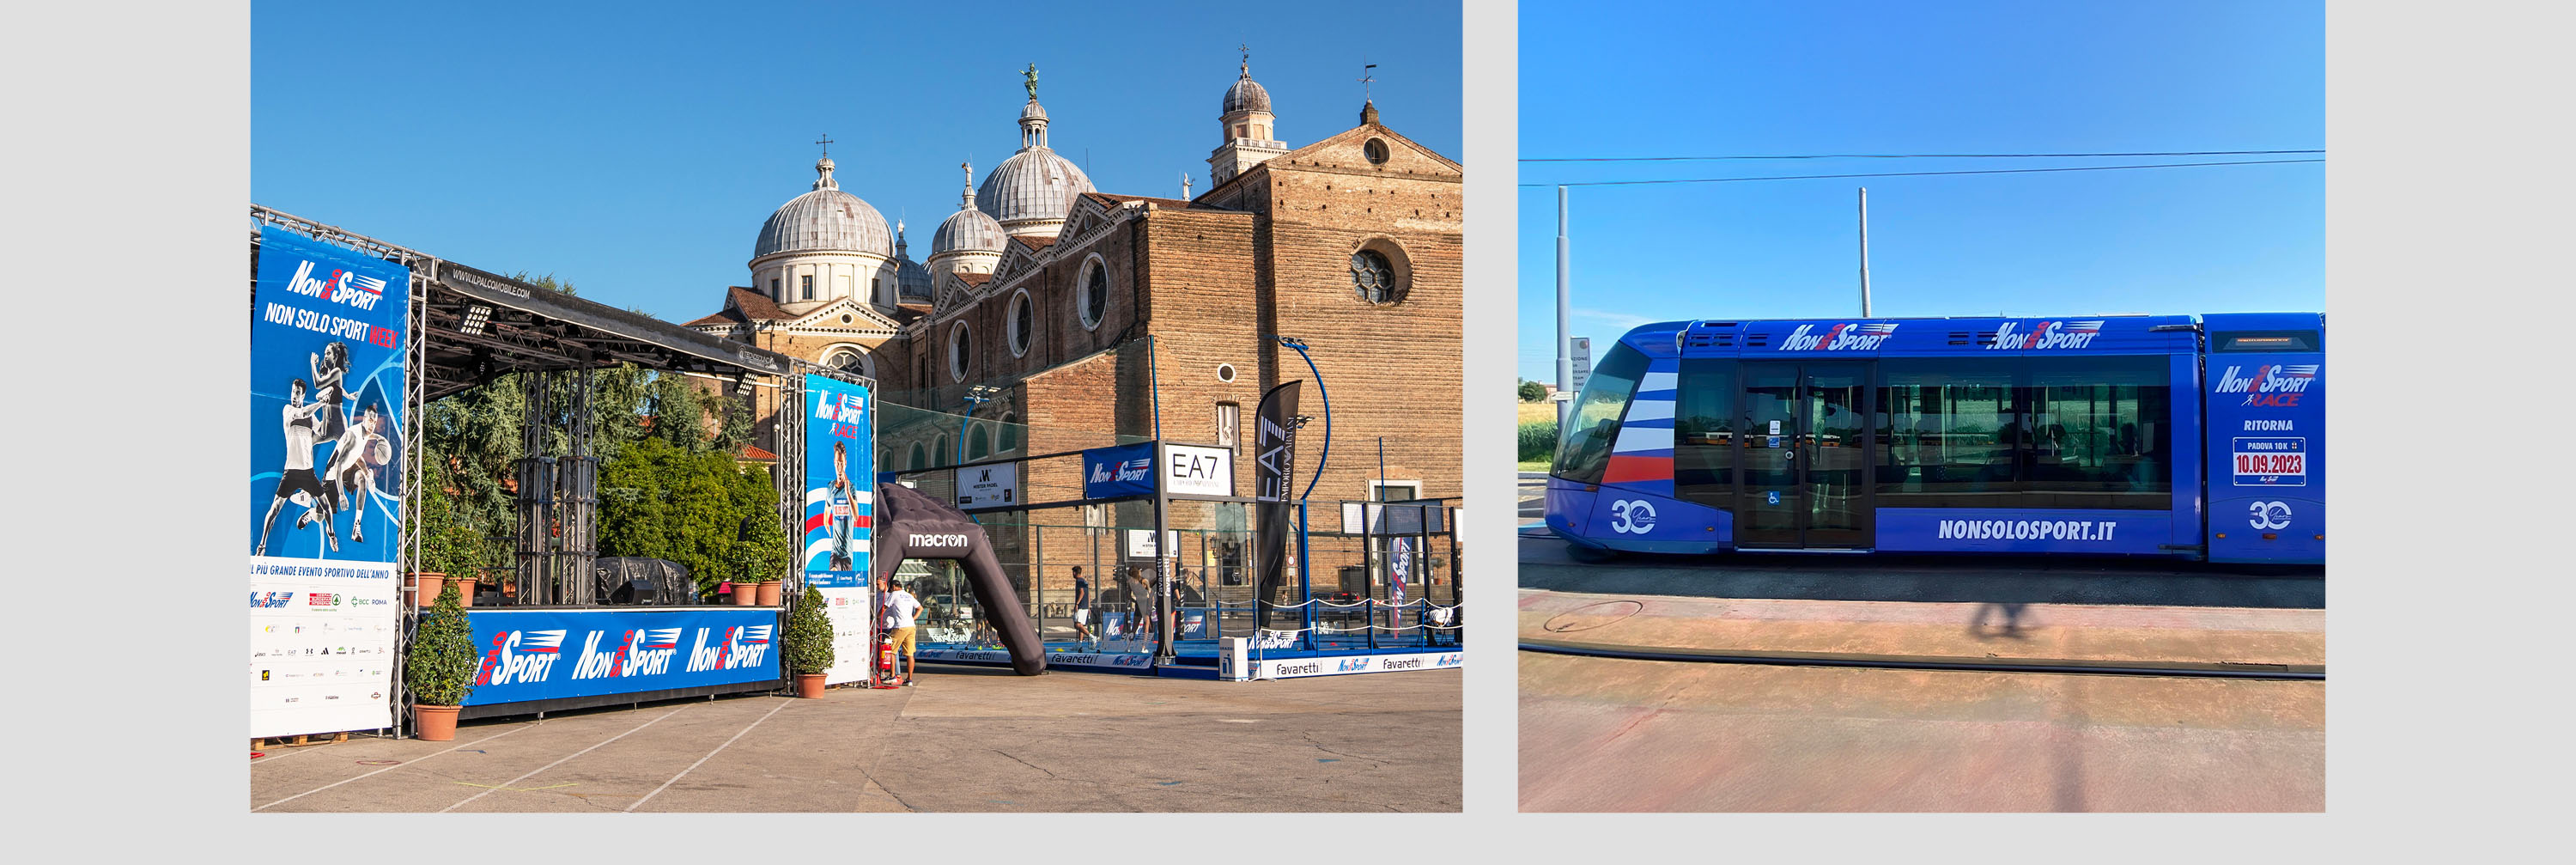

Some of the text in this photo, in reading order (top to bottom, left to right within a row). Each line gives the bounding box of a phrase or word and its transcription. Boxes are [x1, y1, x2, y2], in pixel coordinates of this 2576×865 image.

[264, 302, 398, 350] NON SOLO SPORT WEEK
[2252, 393, 2304, 406] RACE
[834, 423, 858, 439] RACE
[2244, 420, 2293, 430] RITORNA
[1173, 454, 1218, 479] EA7
[1256, 416, 1285, 502] EA7
[2237, 454, 2302, 473] 10.09.2023
[1281, 462, 1291, 502] EMPORIO
[1612, 499, 1656, 534] 30
[2250, 501, 2292, 530] 30
[1938, 520, 2117, 540] NONSOLOSPORT.IT
[908, 533, 968, 547] macron
[256, 562, 269, 575] PIÙ
[270, 565, 297, 576] GRANDE
[298, 566, 323, 577] EVENTO
[324, 567, 355, 578] SPORTIVO
[356, 569, 390, 580] DELL'ANNO
[476, 631, 507, 686] SOLO
[491, 630, 558, 685] SPORT
[956, 651, 992, 661] favaretti
[1051, 653, 1094, 664] favaretti
[1383, 658, 1421, 670] favaretti
[1277, 661, 1319, 675] favaretti
